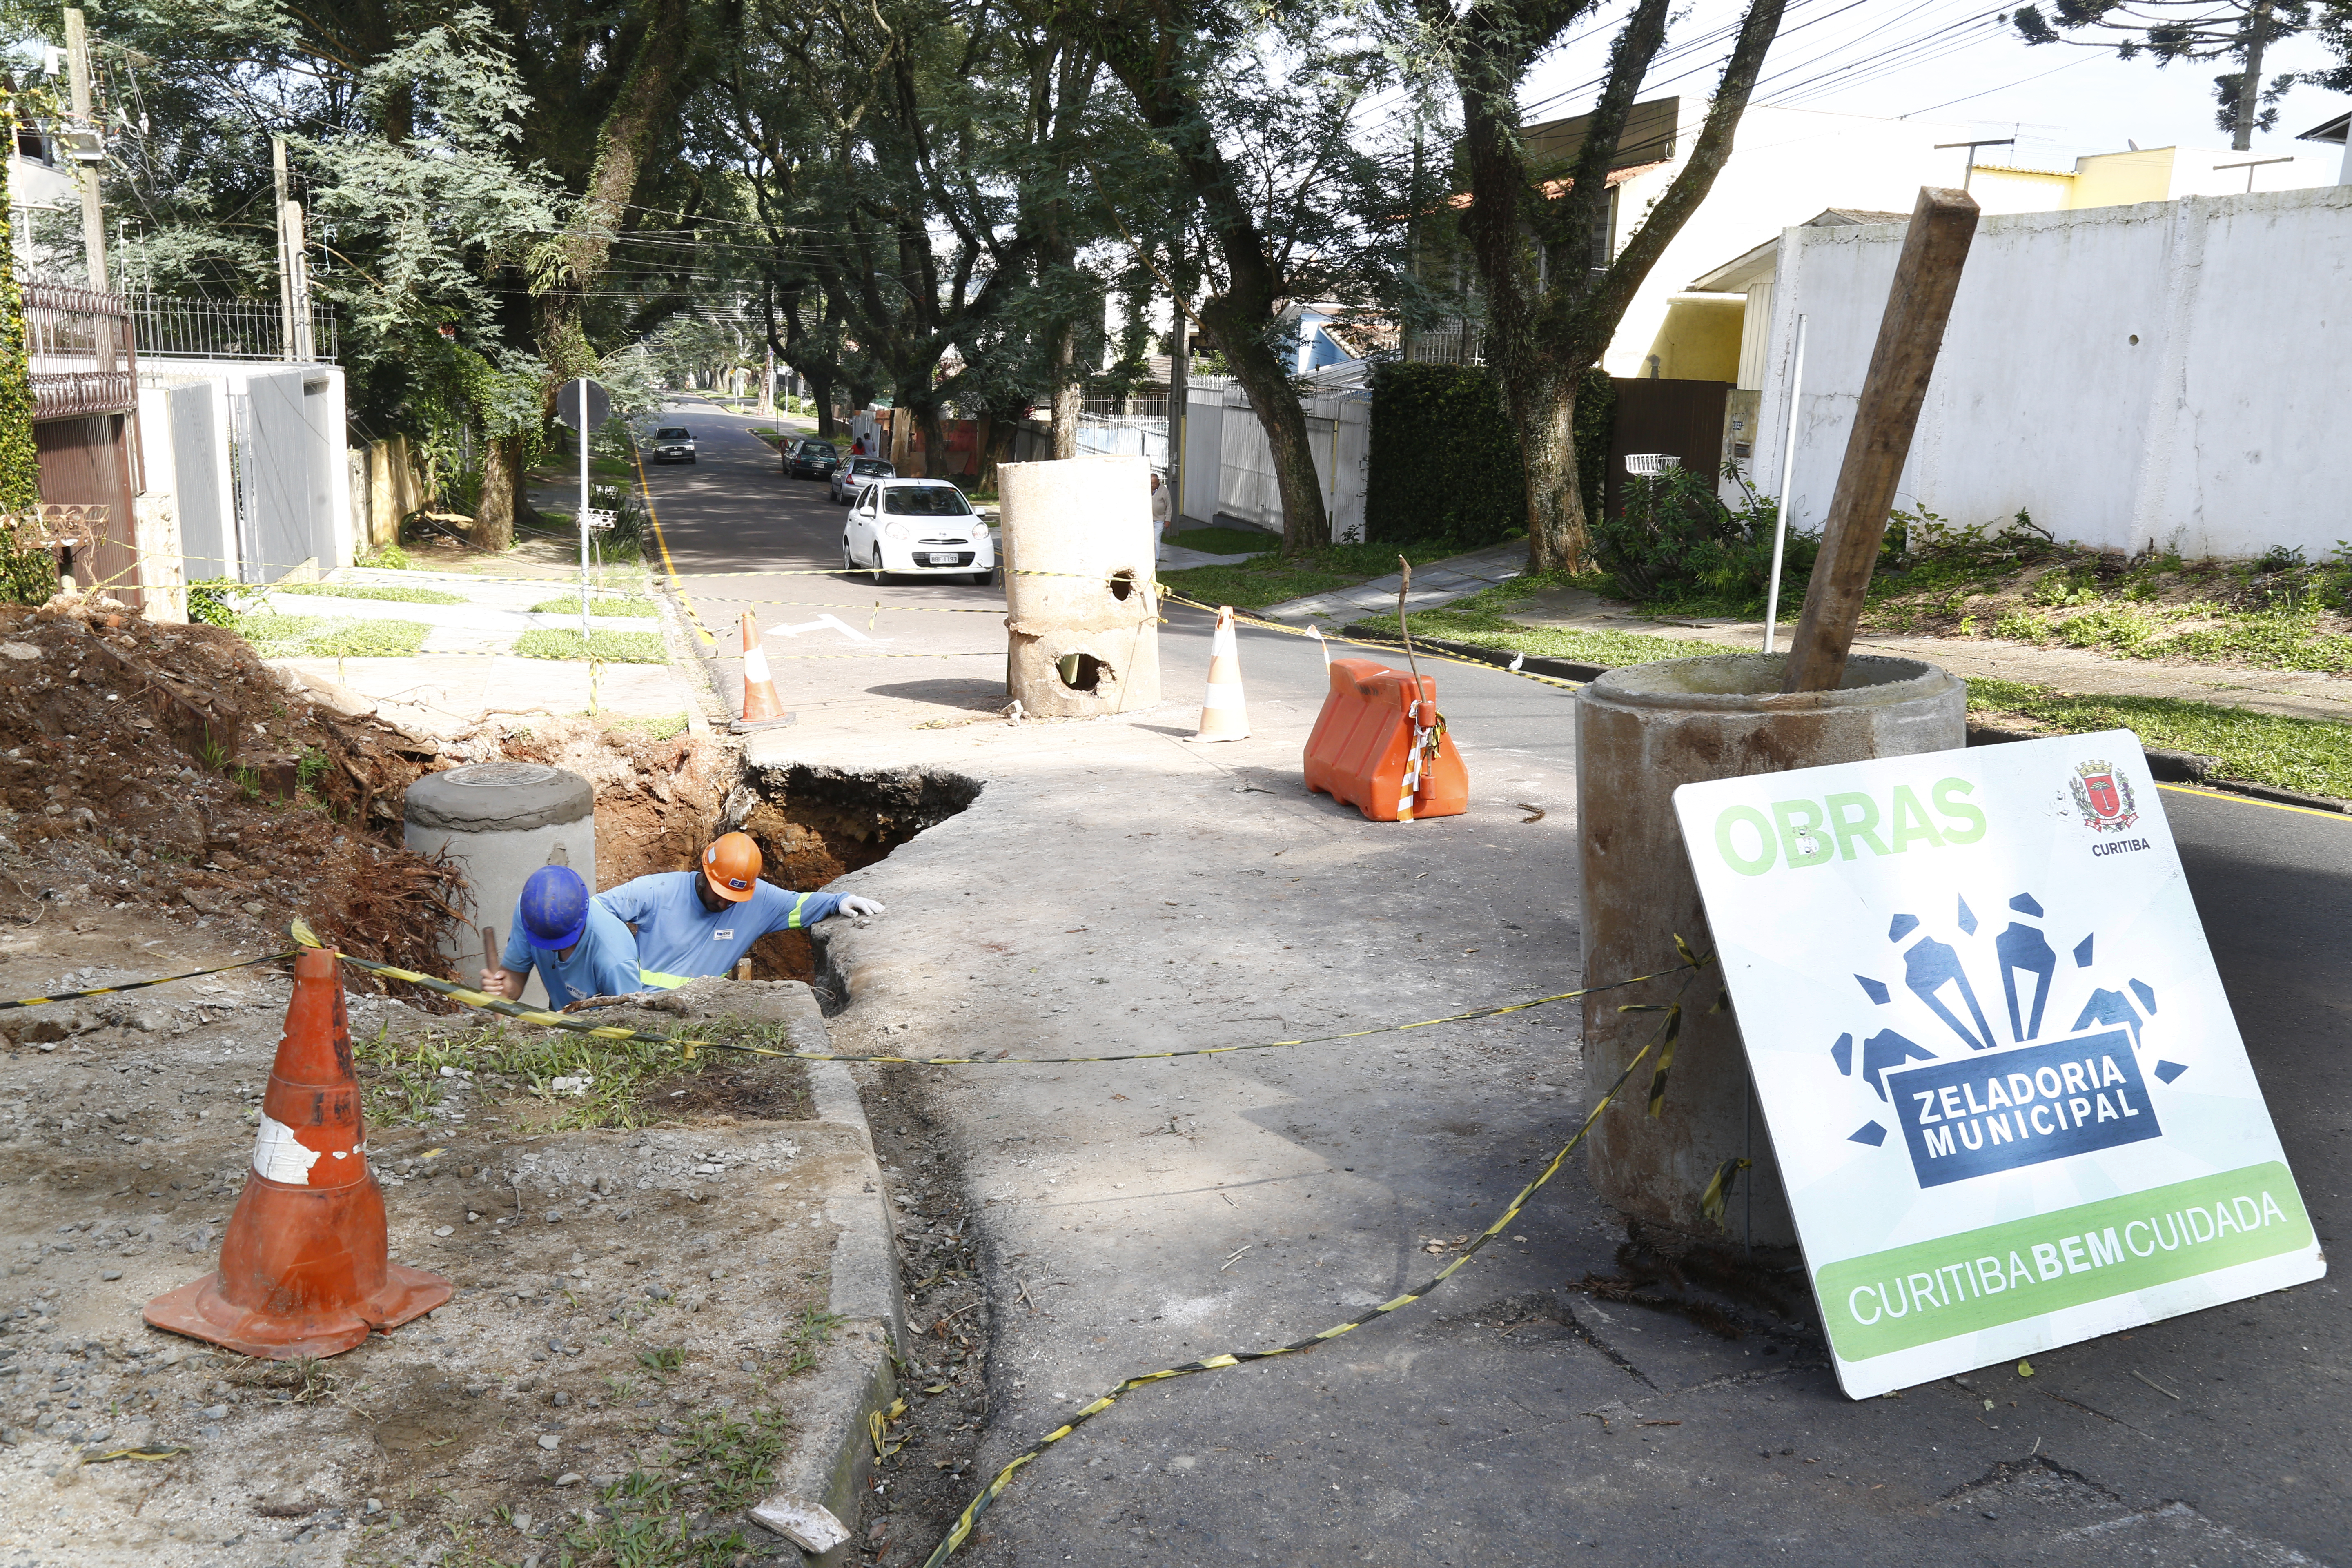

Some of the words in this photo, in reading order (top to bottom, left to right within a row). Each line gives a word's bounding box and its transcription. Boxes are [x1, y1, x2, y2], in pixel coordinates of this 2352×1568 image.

[1714, 777, 1987, 877] OBRAS
[2092, 838, 2151, 857] CURITIBA
[2126, 814, 2136, 825] 1693
[1913, 1055, 2127, 1124] ZELADORIA
[1922, 1089, 2139, 1158] MUNICIPAL
